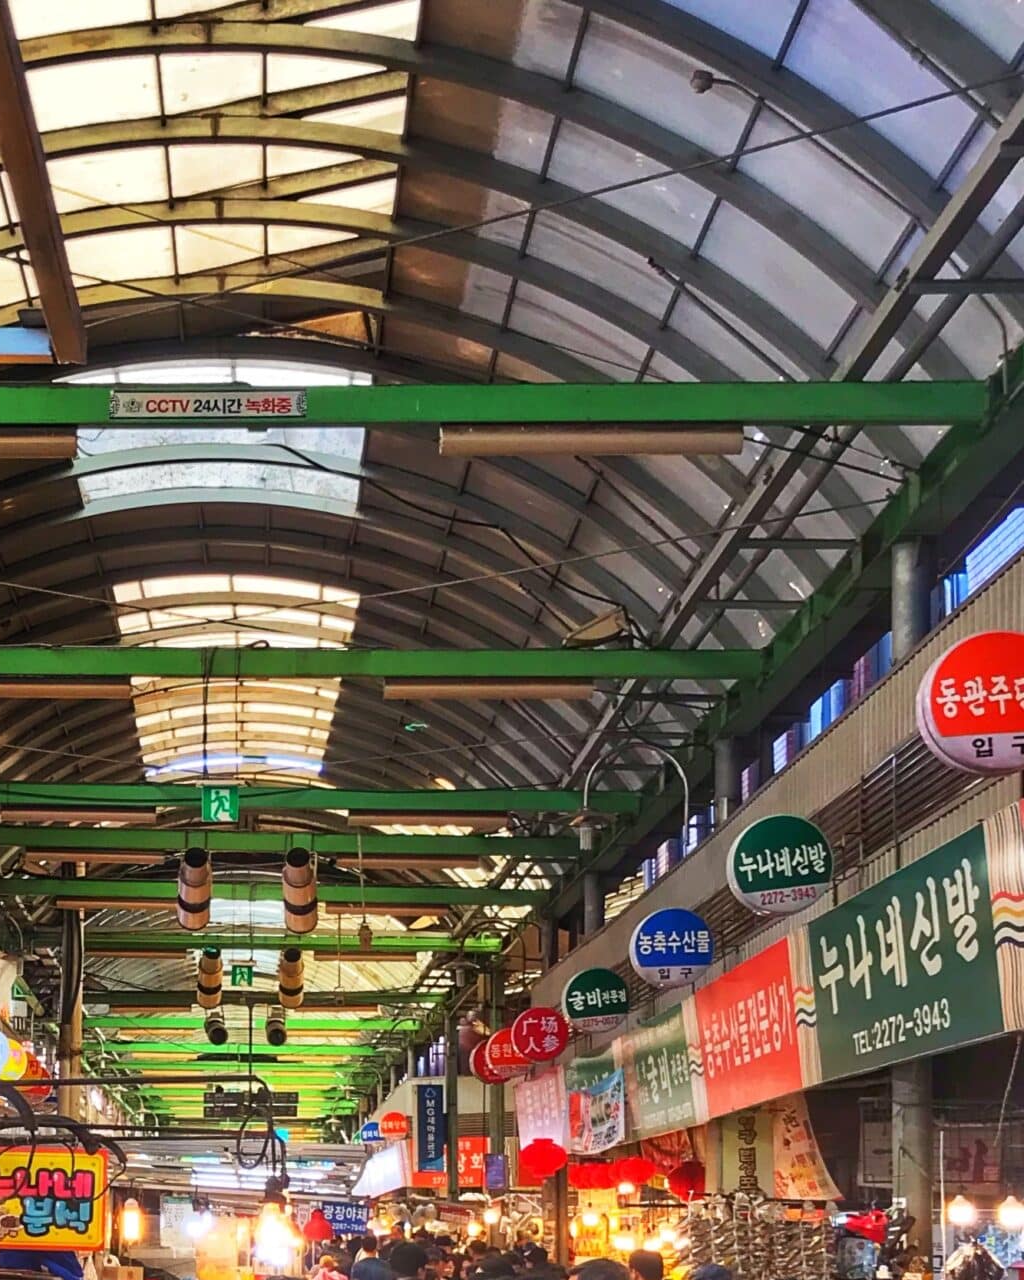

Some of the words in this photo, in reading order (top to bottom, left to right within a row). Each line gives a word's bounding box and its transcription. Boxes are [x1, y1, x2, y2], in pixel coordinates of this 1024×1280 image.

[145, 399, 190, 413] CCTV
[193, 398, 242, 415] 24시간
[245, 398, 292, 414] 녹화중
[738, 842, 827, 882] 누나네신발
[760, 886, 817, 905] 2272-3943
[637, 930, 711, 955] 농축수산물
[818, 858, 980, 1015] 누나네신발
[521, 1016, 559, 1036] 广场
[523, 1036, 560, 1054] 人参
[21, 1196, 91, 1236] 분식
